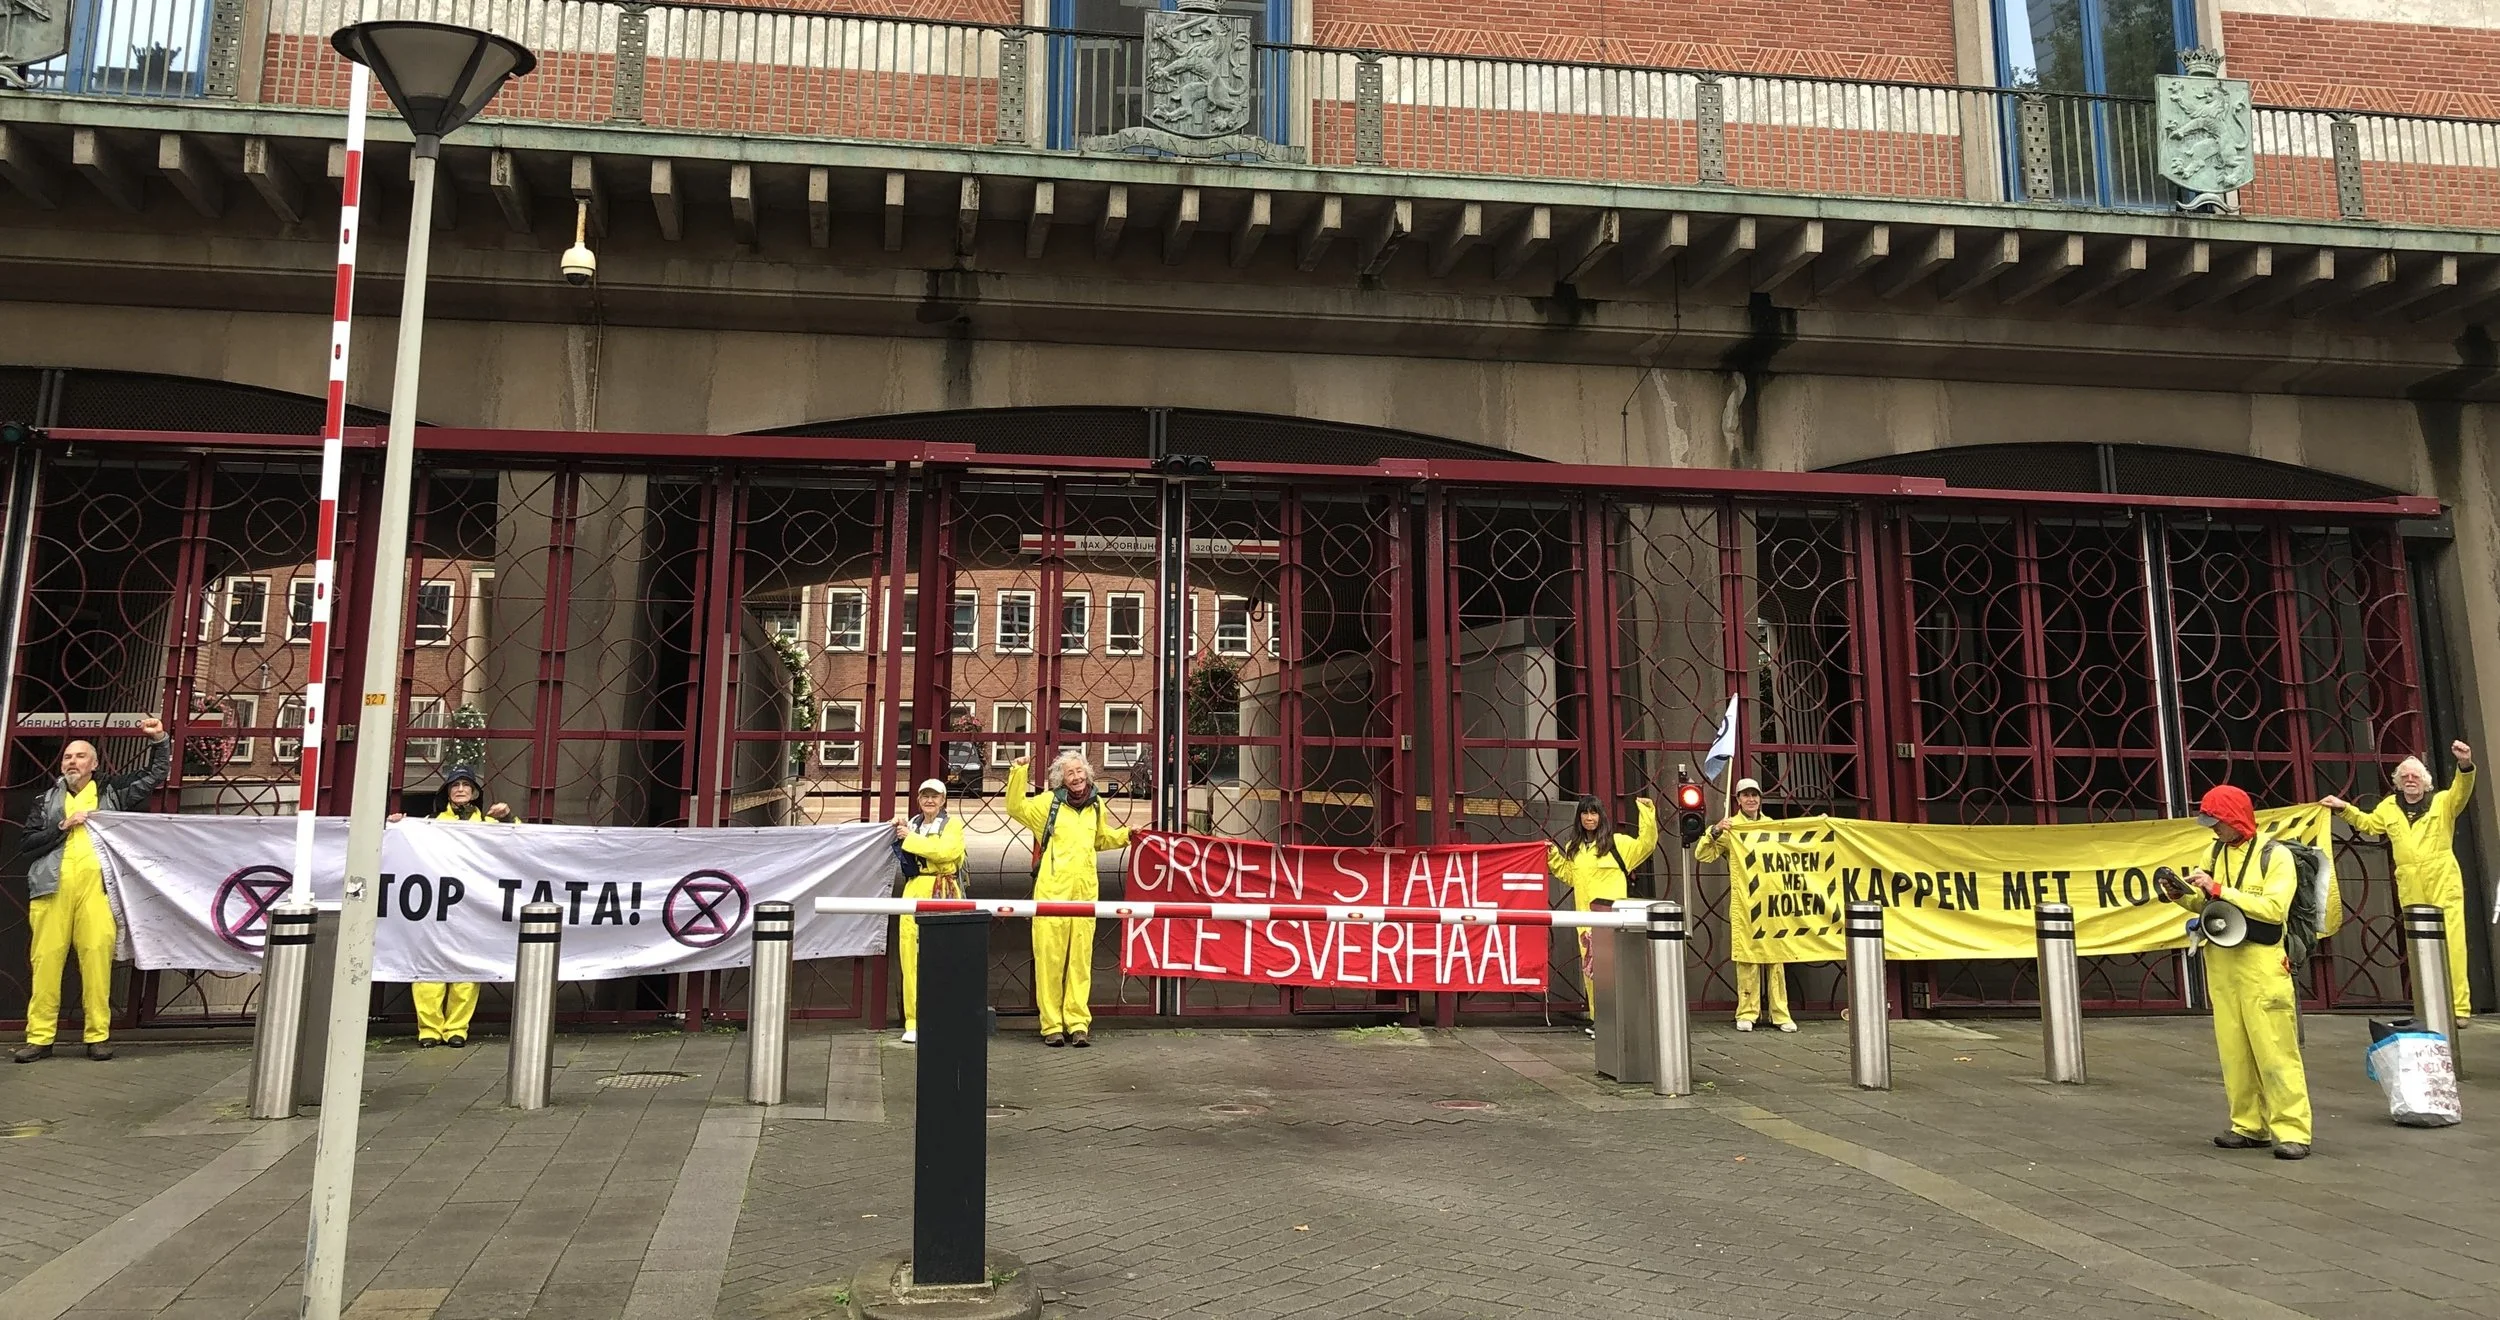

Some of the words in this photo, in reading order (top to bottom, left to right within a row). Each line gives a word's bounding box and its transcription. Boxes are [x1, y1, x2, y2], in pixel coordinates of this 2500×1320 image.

[1213, 544, 1228, 552] CM
[365, 693, 387, 706] 527
[113, 719, 131, 728] 190
[1133, 835, 1304, 900] GROEN
[1762, 851, 1820, 873] KAPPEN
[1782, 873, 1808, 891] MET
[1841, 867, 1980, 911] KAPPEN
[2002, 870, 2071, 911] MET
[376, 873, 466, 922] TOP
[498, 879, 643, 926] TATA!
[1767, 892, 1826, 918] KOLEN
